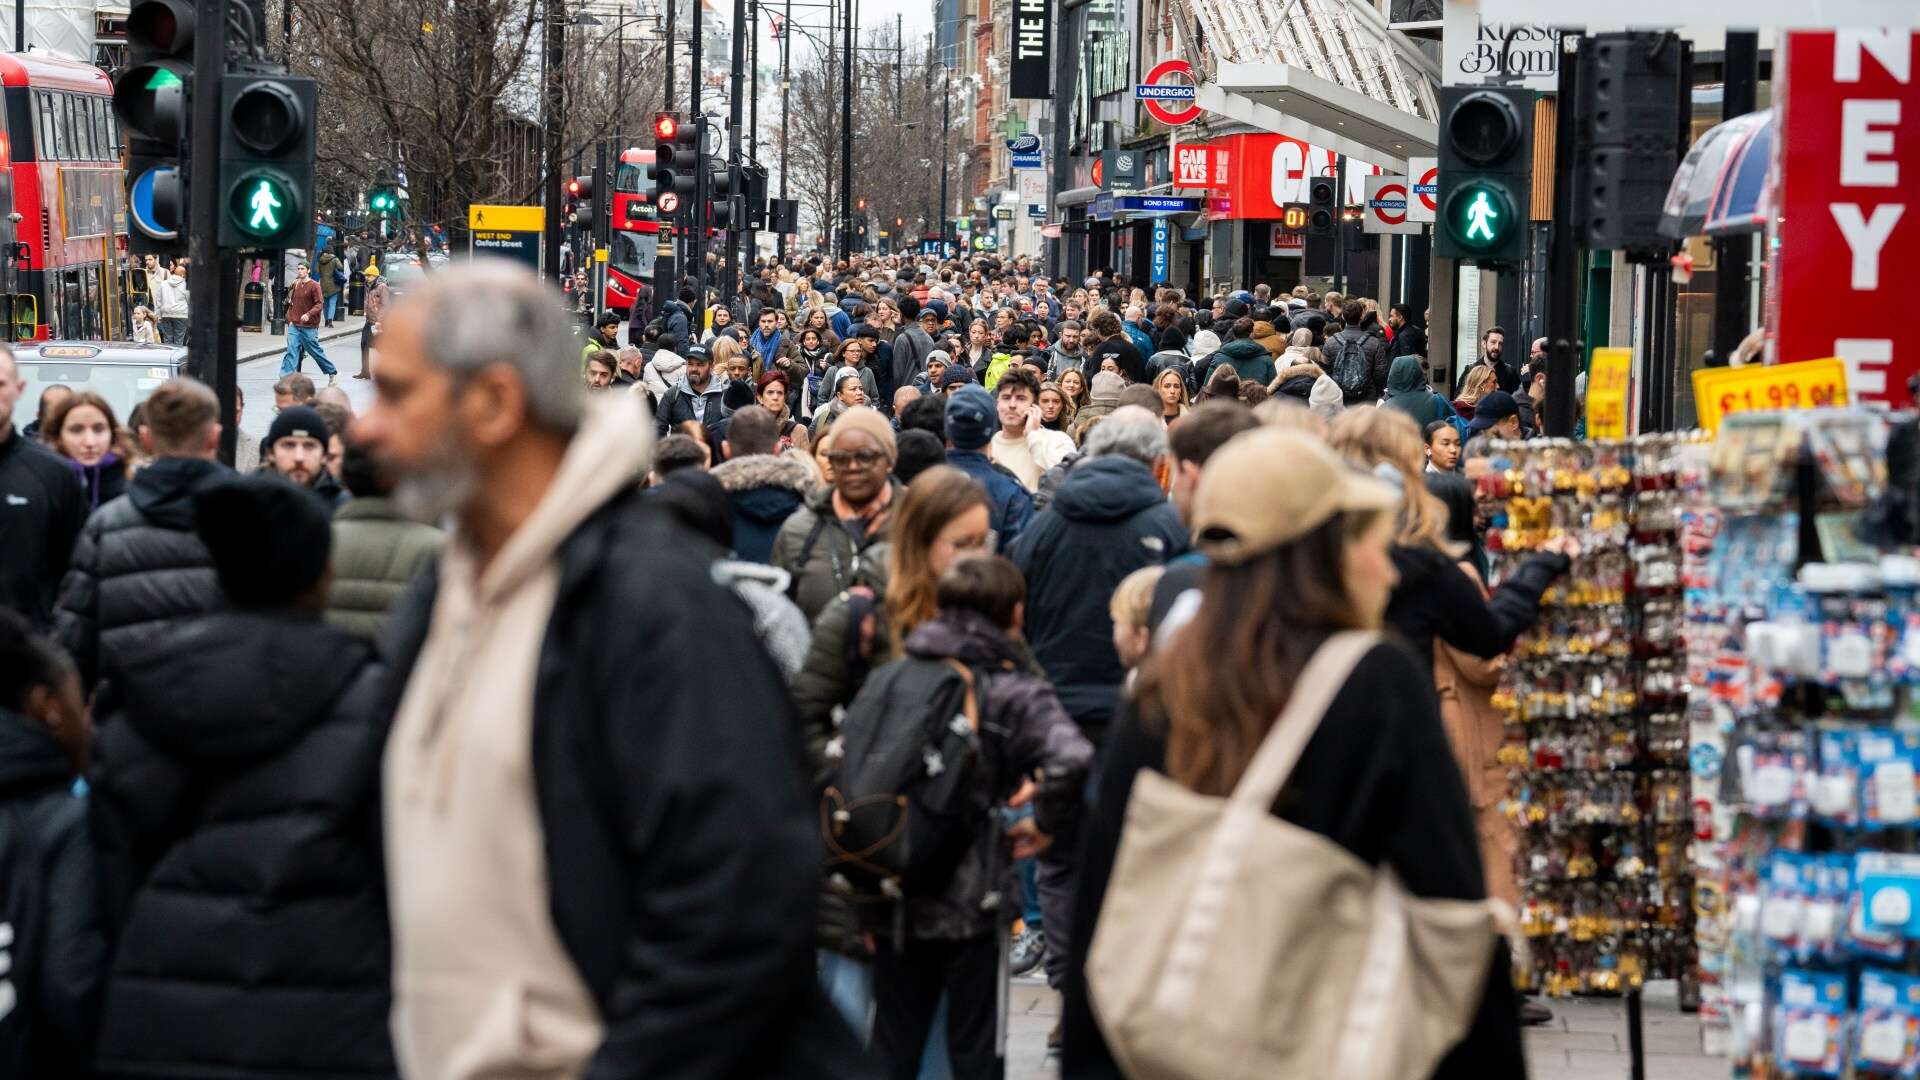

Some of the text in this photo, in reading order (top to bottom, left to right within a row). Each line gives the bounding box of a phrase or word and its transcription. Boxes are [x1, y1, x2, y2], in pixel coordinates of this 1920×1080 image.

[1018, 18, 1043, 60] THE
[1179, 149, 1207, 164] CAN
[631, 204, 653, 213] Acton
[1286, 210, 1305, 226] 01
[475, 232, 496, 240] WEST
[475, 240, 500, 248] Oxford
[1155, 219, 1167, 276] MONEY
